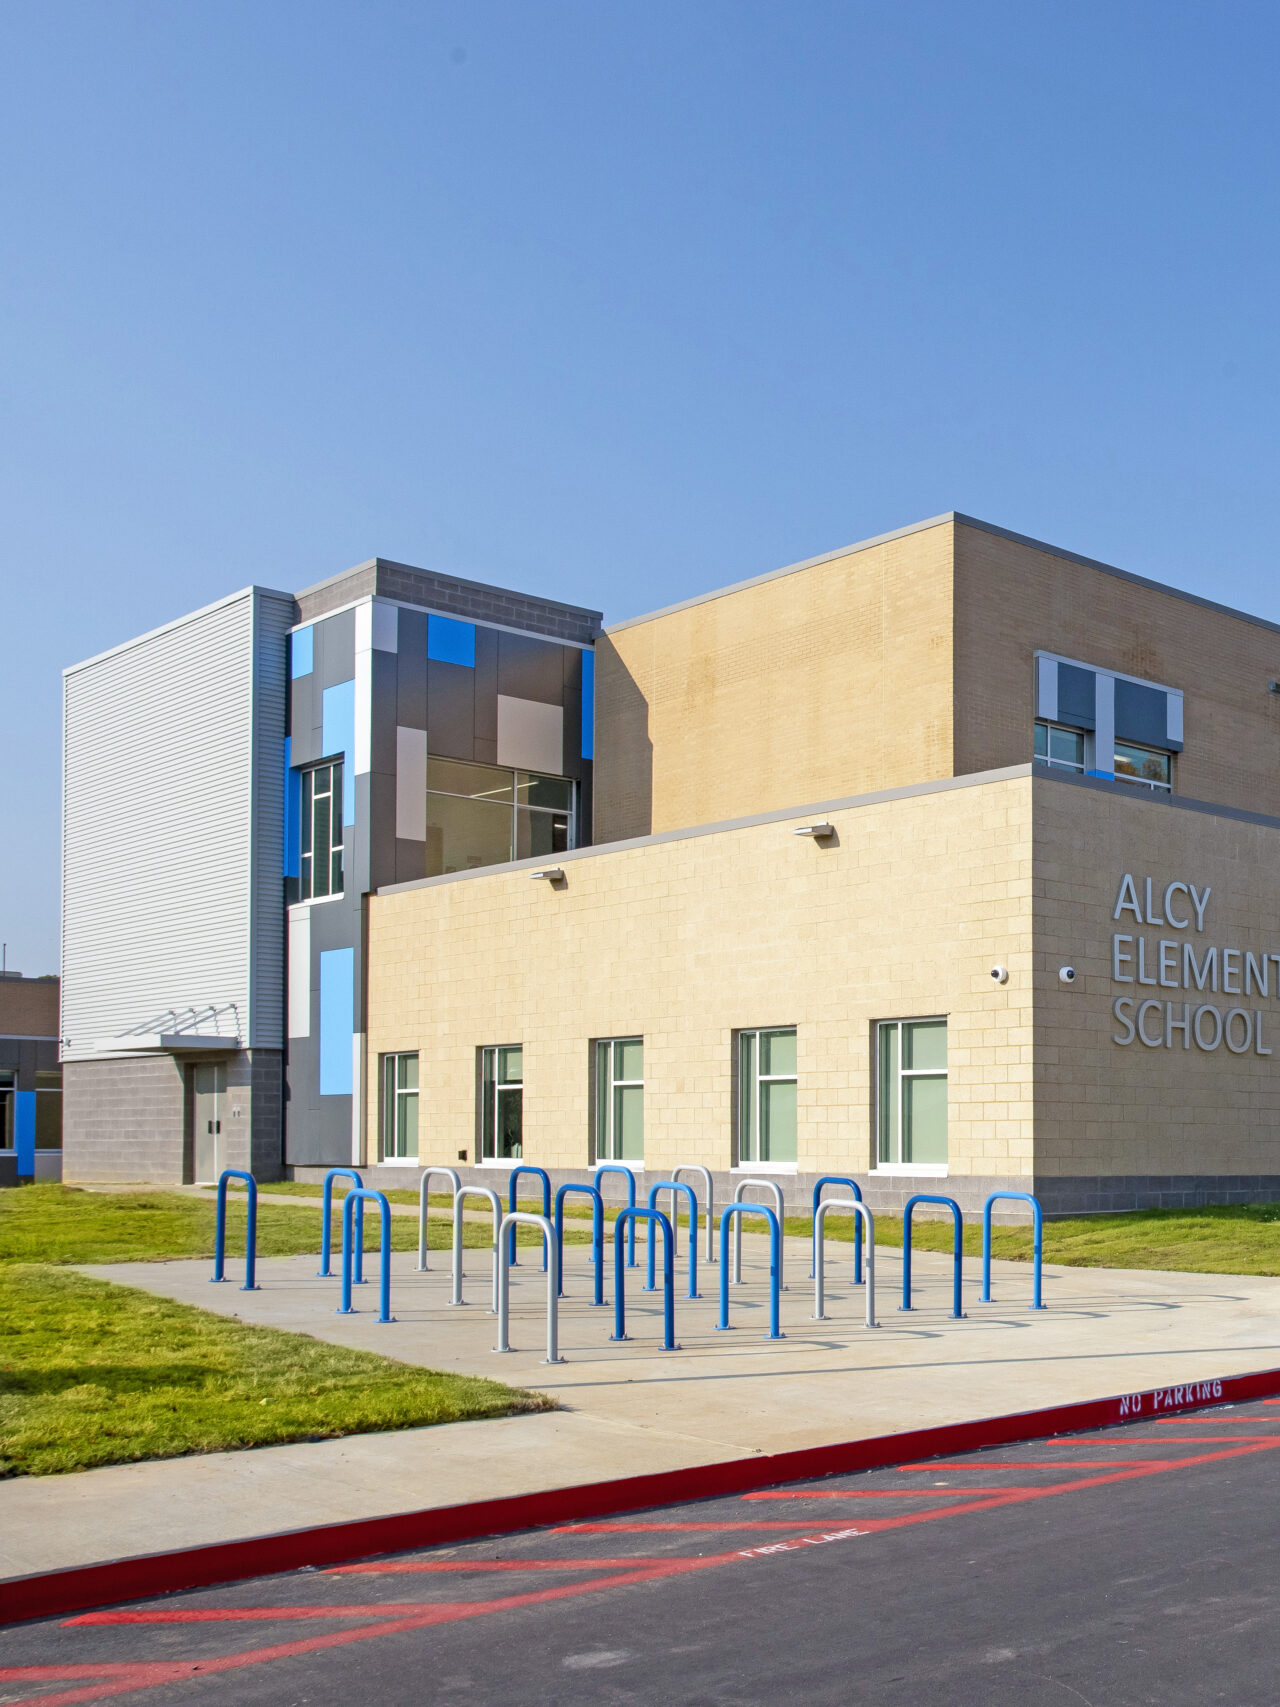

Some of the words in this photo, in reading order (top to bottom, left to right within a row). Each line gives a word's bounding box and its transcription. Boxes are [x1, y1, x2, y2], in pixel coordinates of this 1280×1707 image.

[1112, 873, 1211, 932] ALCY
[1112, 996, 1273, 1056] SCHOOL
[1119, 1394, 1142, 1416] NO
[1153, 1379, 1222, 1409] PARKING
[738, 1543, 800, 1557] FIRE
[802, 1528, 870, 1544] LANE
